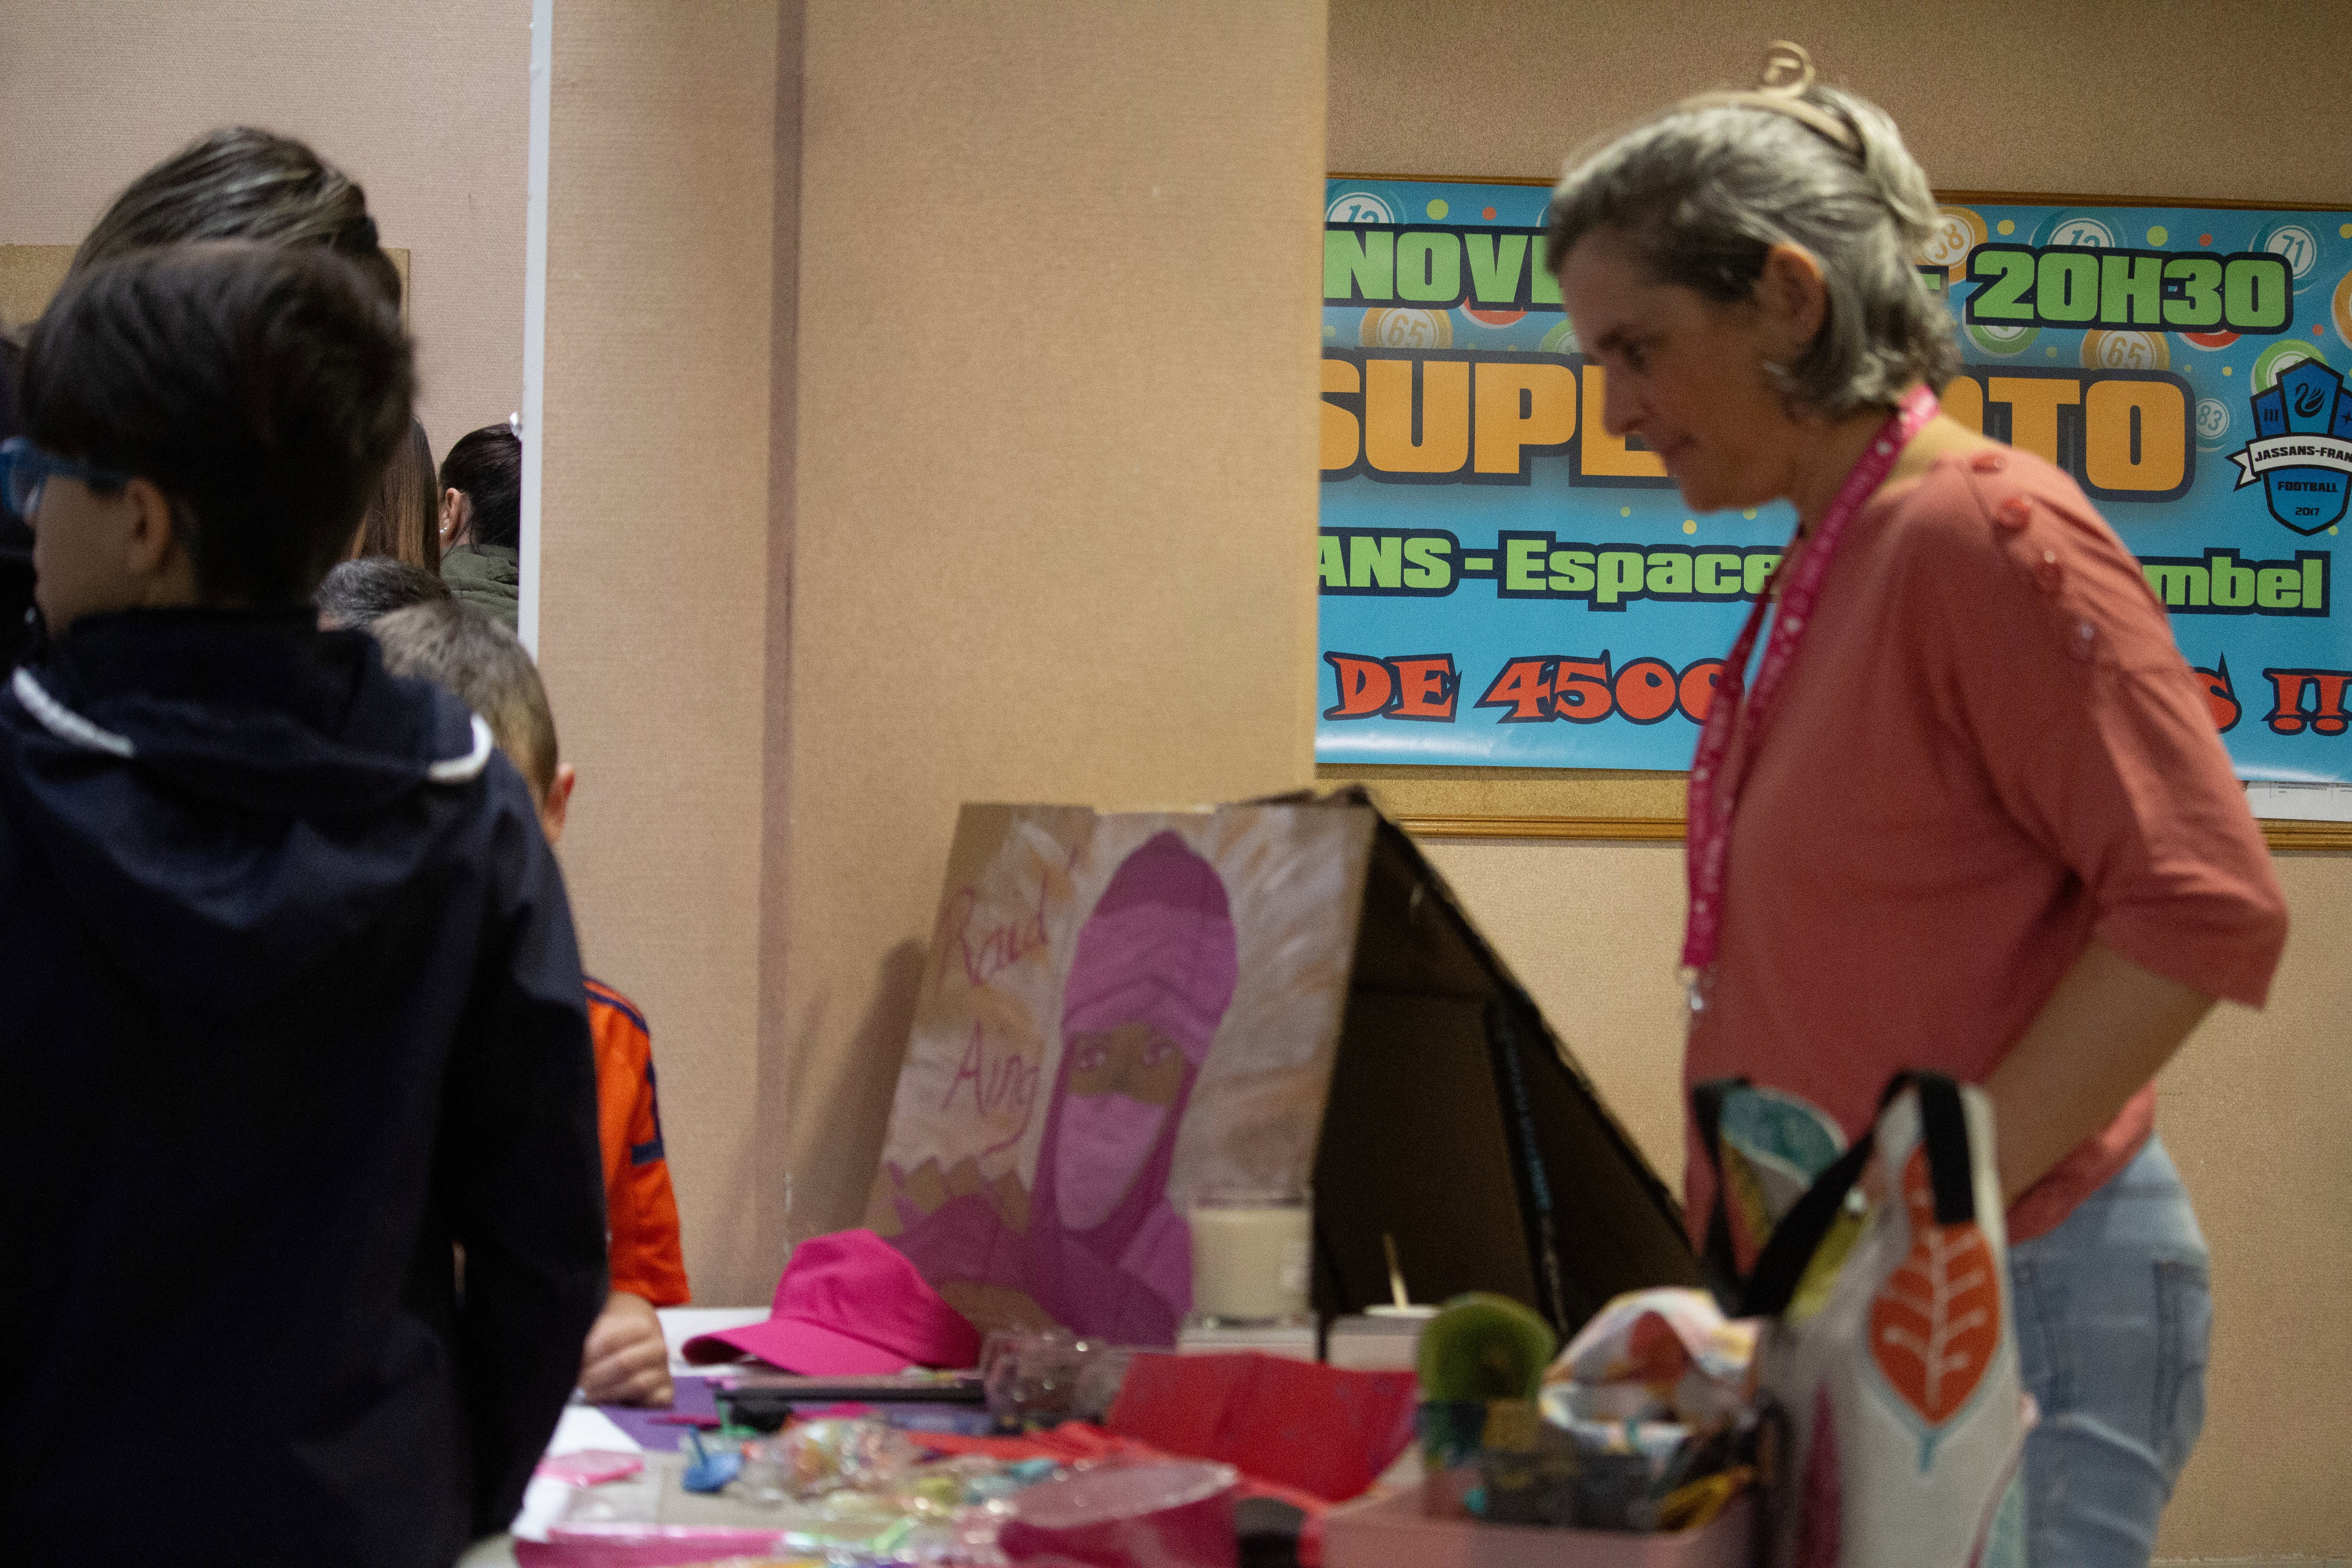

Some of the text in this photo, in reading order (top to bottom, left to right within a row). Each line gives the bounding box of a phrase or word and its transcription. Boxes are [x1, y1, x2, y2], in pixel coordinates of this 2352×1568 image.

[1972, 249, 2288, 328] 20H30
[2277, 481, 2338, 493] FOOTBALL
[2294, 507, 2320, 516] 2017
[1327, 654, 1455, 720] DE
